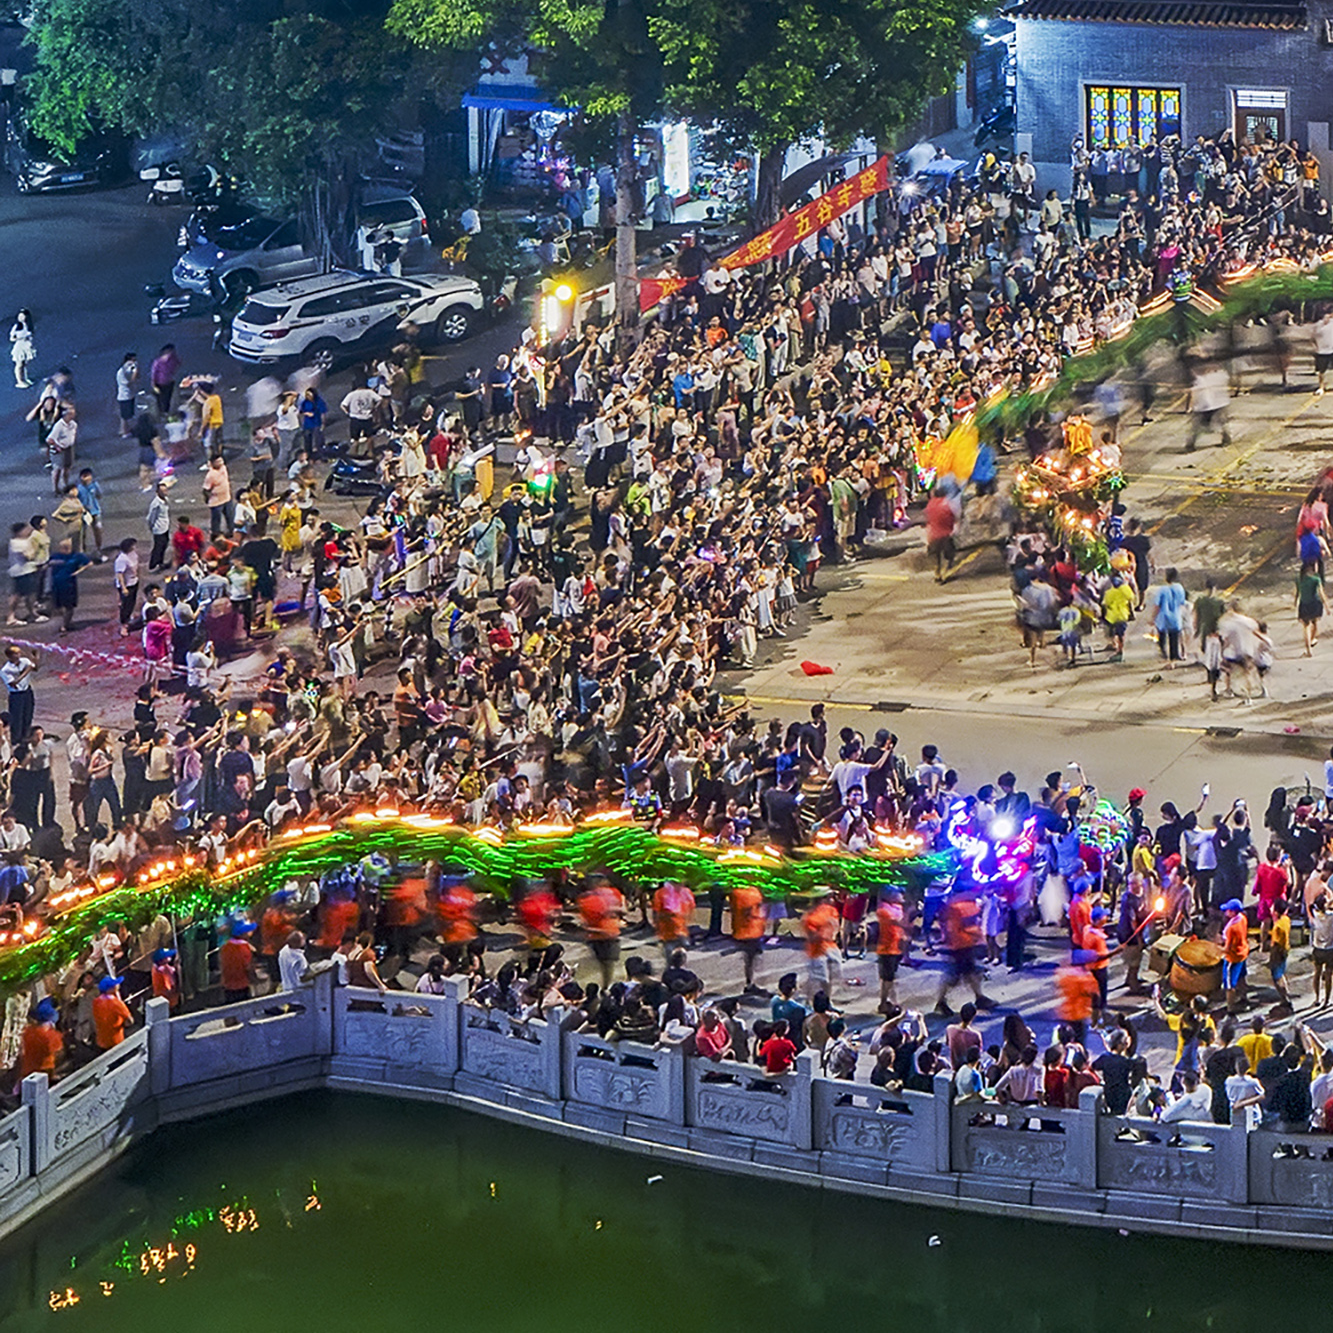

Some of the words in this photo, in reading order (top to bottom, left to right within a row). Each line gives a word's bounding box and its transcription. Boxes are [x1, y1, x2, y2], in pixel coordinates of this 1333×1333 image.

[793, 168, 878, 240] 五谷丰登
[345, 315, 370, 328] 公安
